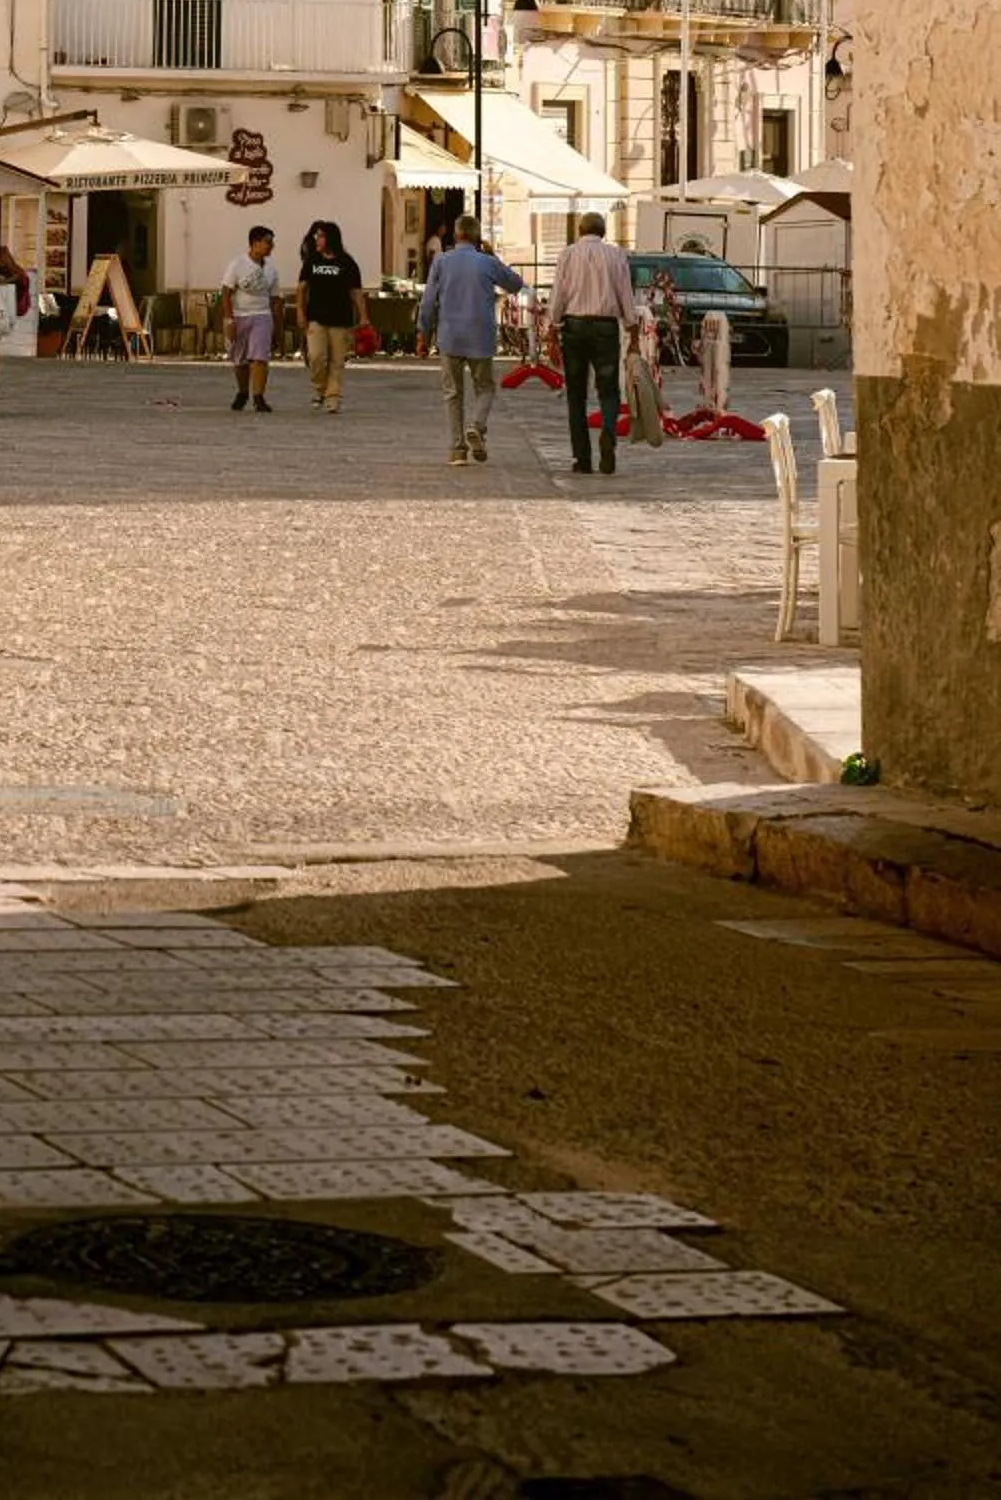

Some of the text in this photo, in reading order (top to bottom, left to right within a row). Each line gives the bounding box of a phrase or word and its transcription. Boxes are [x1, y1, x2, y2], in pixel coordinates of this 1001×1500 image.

[66, 171, 230, 188] RISTORANTE PIZZERIA PRINCIPE
